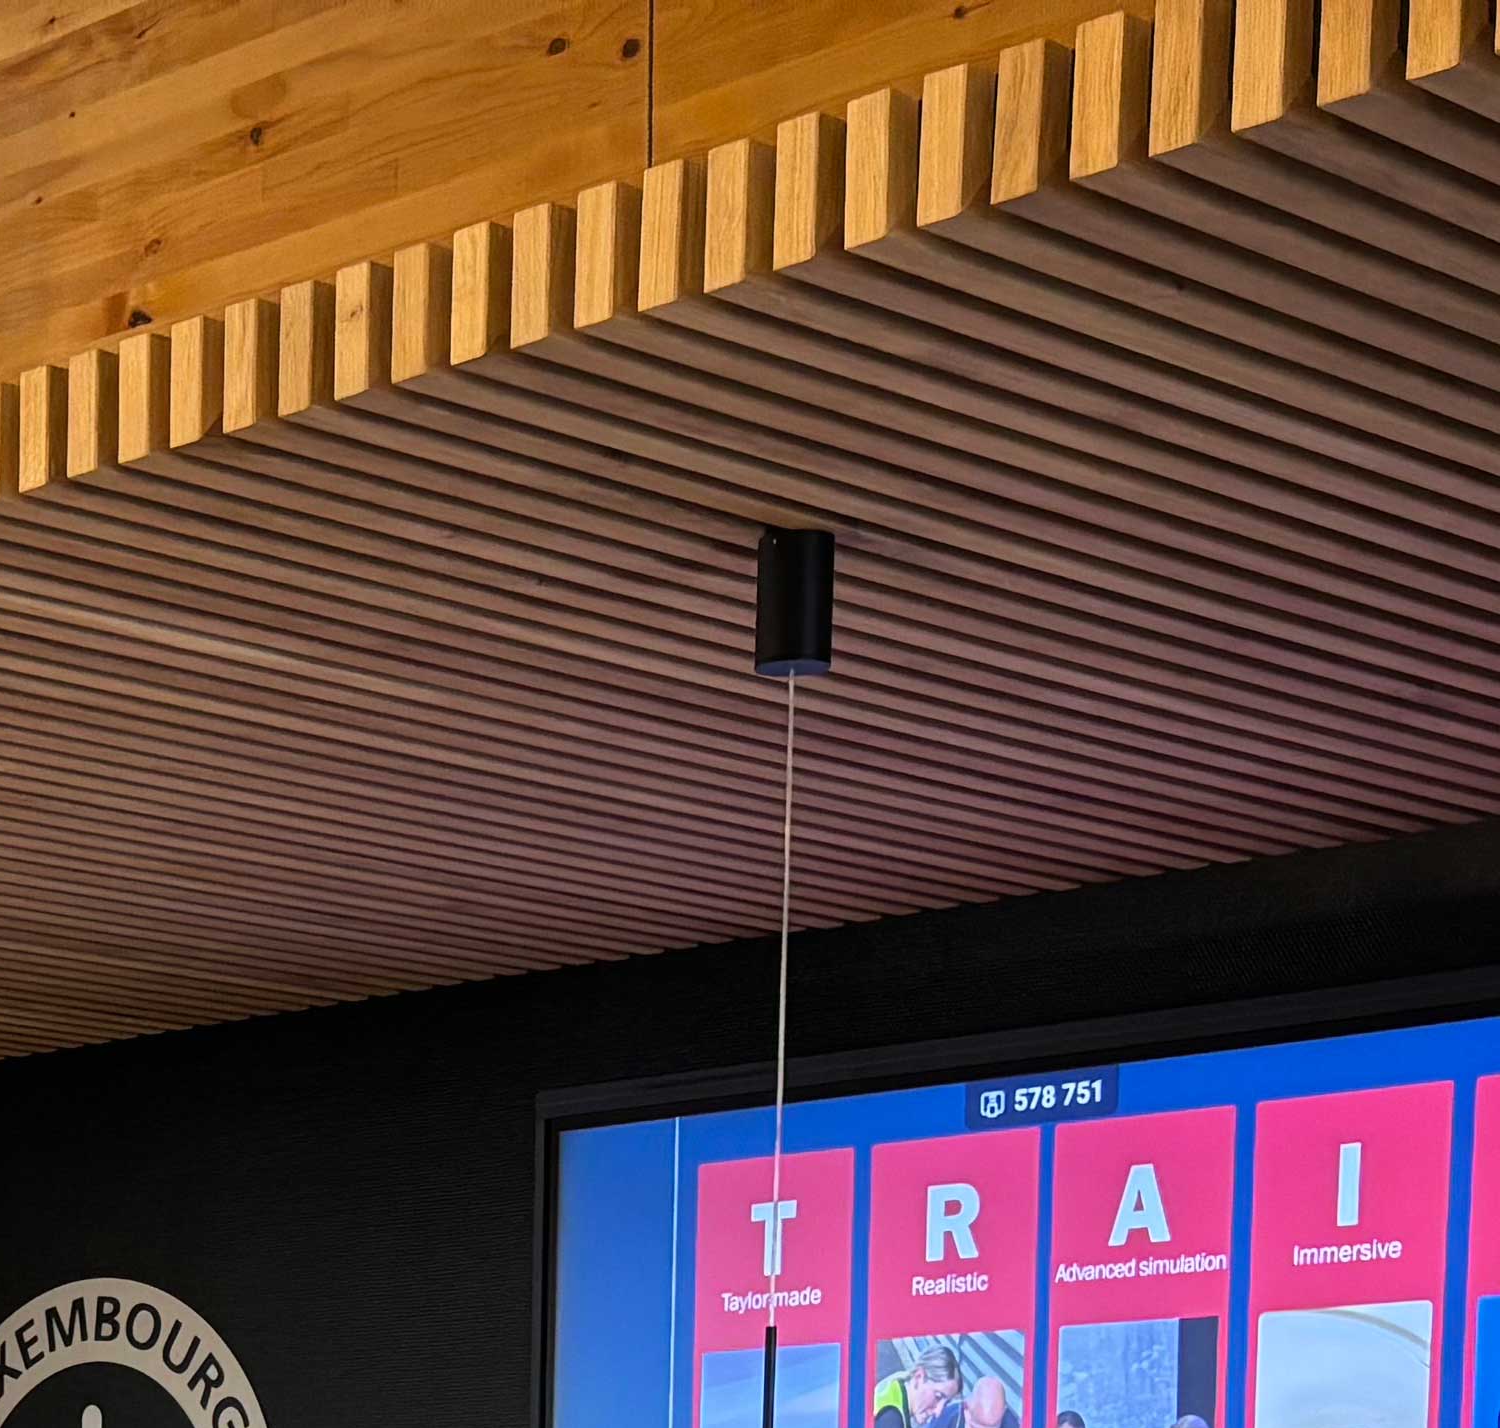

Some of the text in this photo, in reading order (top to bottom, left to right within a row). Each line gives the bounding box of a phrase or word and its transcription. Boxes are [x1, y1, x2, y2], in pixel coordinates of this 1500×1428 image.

[1014, 1079, 1102, 1112] 578 751
[1108, 1163, 1171, 1247] A
[1336, 1142, 1362, 1227] I
[751, 1199, 798, 1277] T
[925, 1182, 981, 1263] R
[1054, 1250, 1228, 1284] Advanced simulation
[1292, 1238, 1403, 1267] Immersive
[911, 1271, 989, 1297] Realistic
